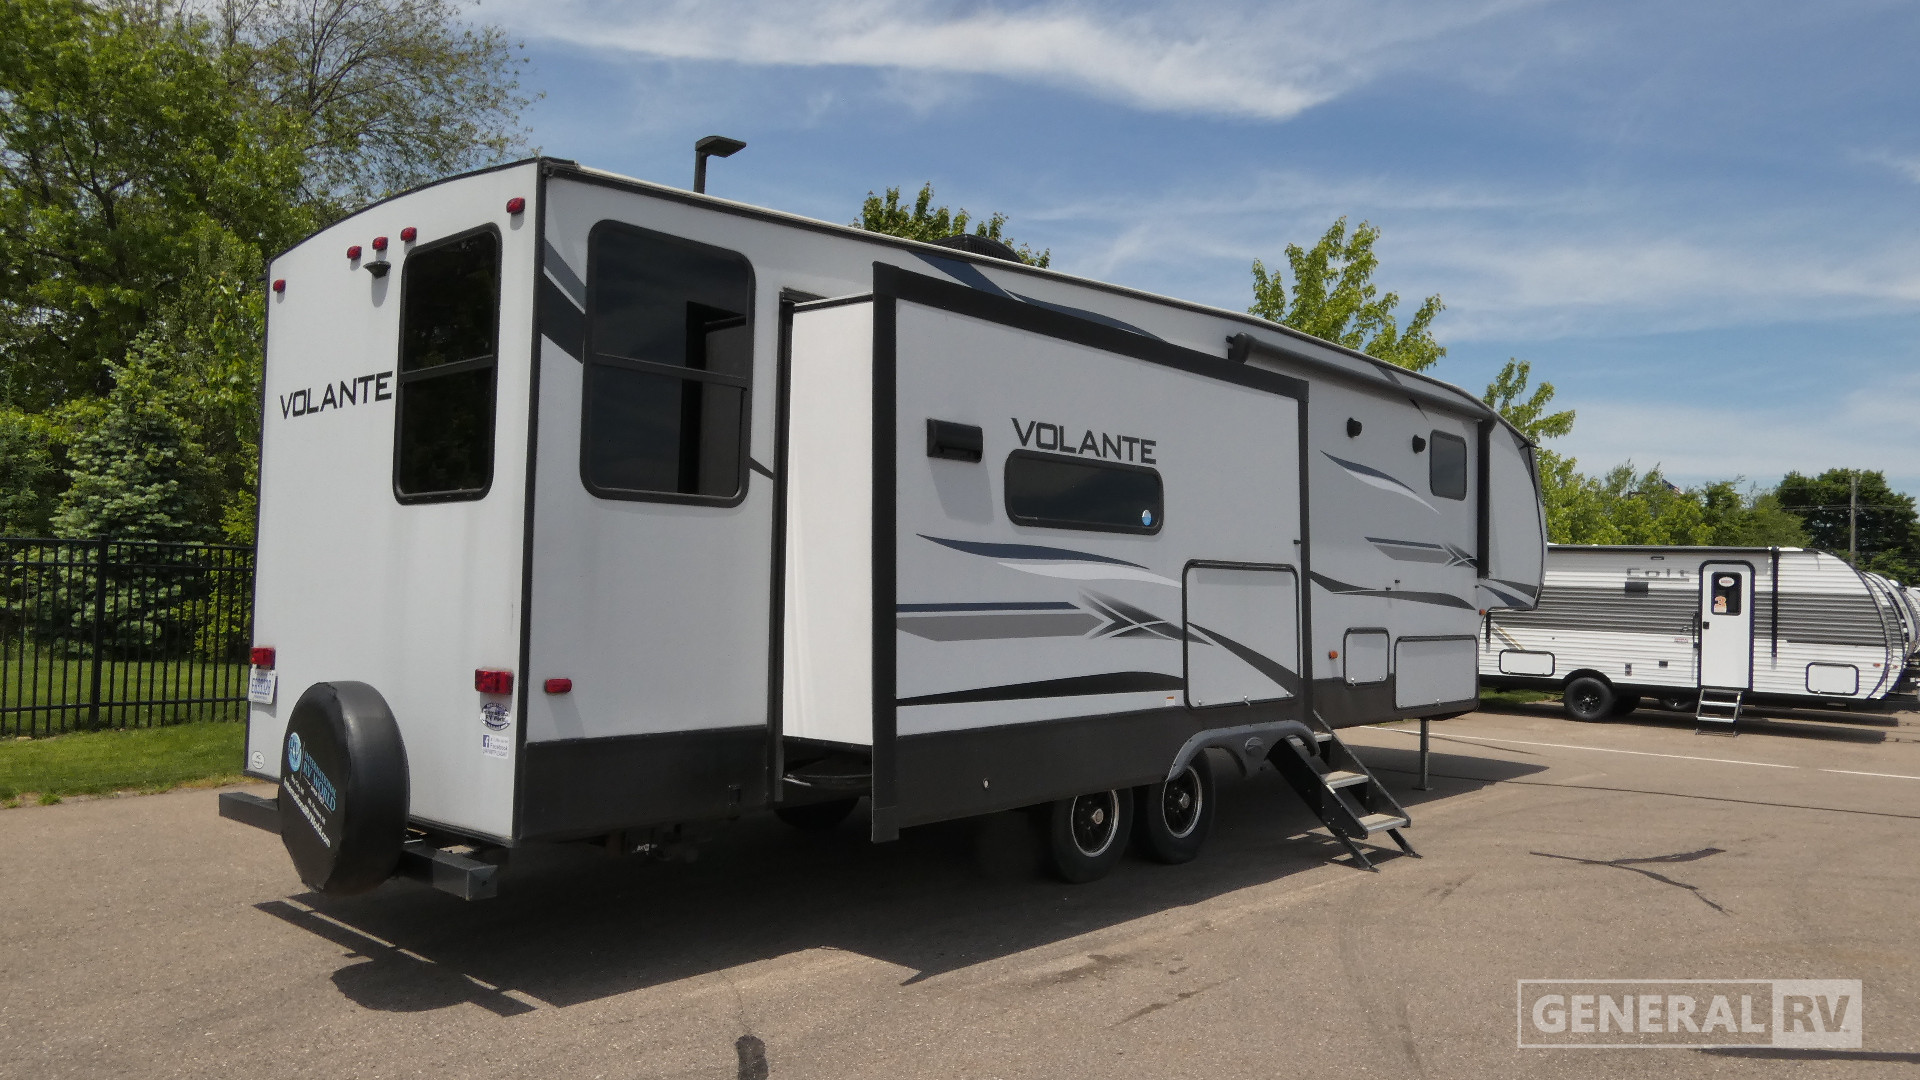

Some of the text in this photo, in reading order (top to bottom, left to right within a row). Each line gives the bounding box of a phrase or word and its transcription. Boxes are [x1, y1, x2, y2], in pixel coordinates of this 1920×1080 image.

[280, 371, 393, 420] VOLANTE
[1010, 417, 1157, 465] VOLANTE
[303, 761, 312, 778] RV
[313, 773, 336, 812] WORLD
